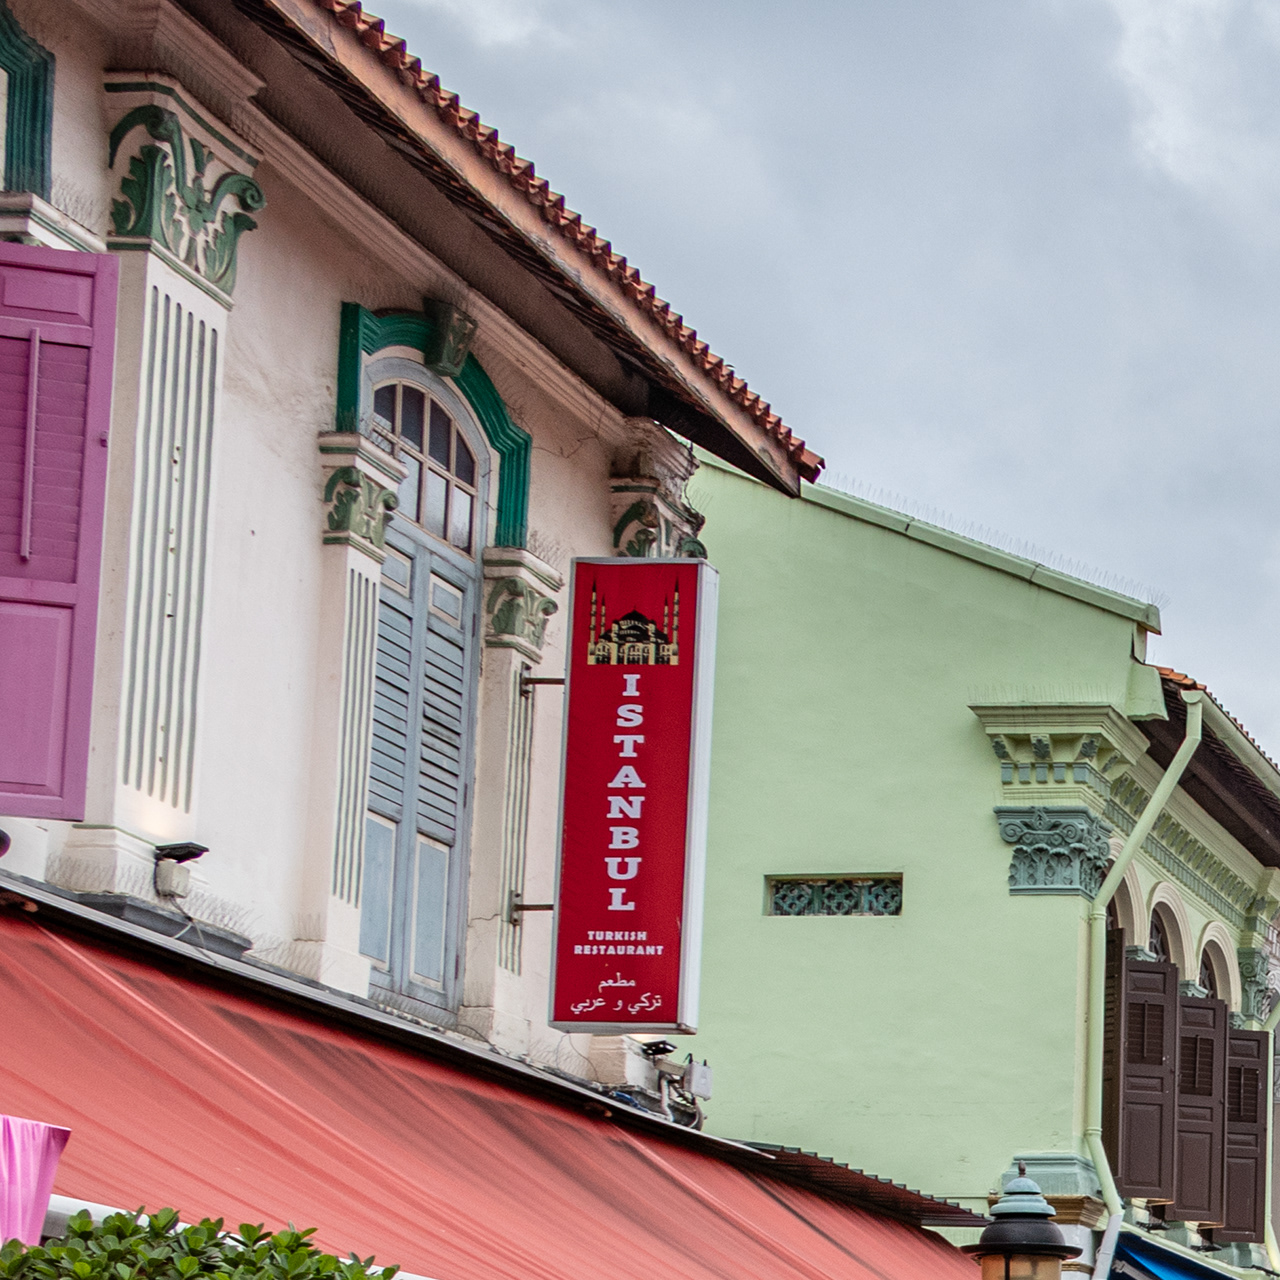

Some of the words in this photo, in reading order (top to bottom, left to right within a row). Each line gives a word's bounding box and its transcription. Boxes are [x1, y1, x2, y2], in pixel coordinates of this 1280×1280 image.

[604, 674, 646, 911] ISTANBUL
[587, 931, 648, 941] TURKISH
[574, 945, 664, 955] RESTAURANT
[598, 972, 636, 993] مطعم
[570, 998, 606, 1015] عربي
[627, 992, 662, 1015] تركي
